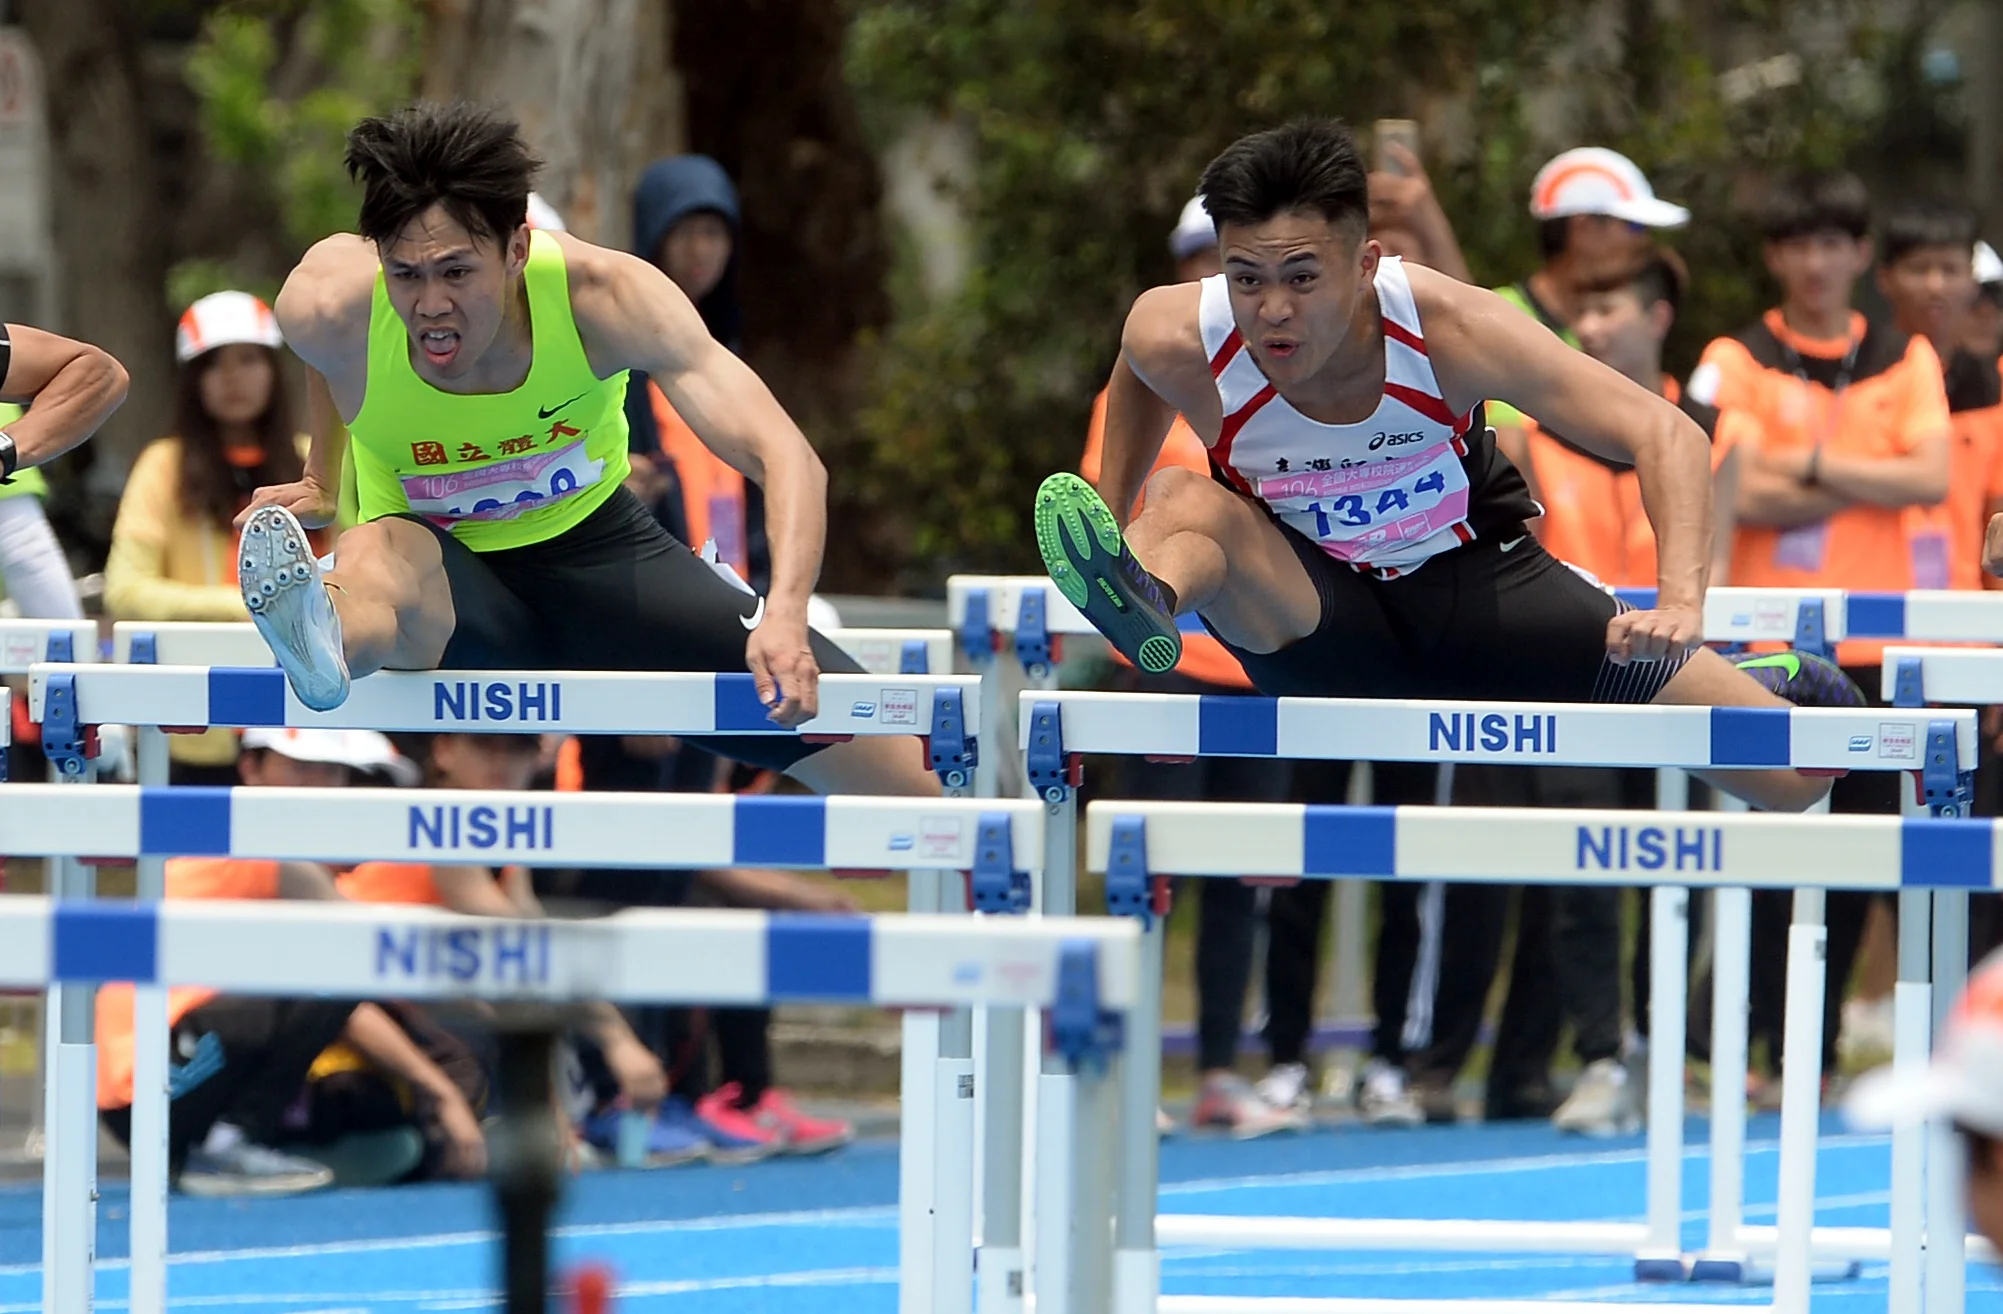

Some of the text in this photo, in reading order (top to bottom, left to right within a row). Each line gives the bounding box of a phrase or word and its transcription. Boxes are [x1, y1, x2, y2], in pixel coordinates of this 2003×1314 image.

[411, 419, 581, 466] 國立體大
[1387, 431, 1424, 446] asics
[423, 475, 458, 499] 106
[1301, 470, 1446, 538] 1344
[436, 682, 560, 721] NISHI
[1429, 712, 1556, 753] NISHI
[409, 805, 553, 850] NISHI
[1576, 826, 1722, 871] NISHI
[375, 925, 552, 981] NISHI
